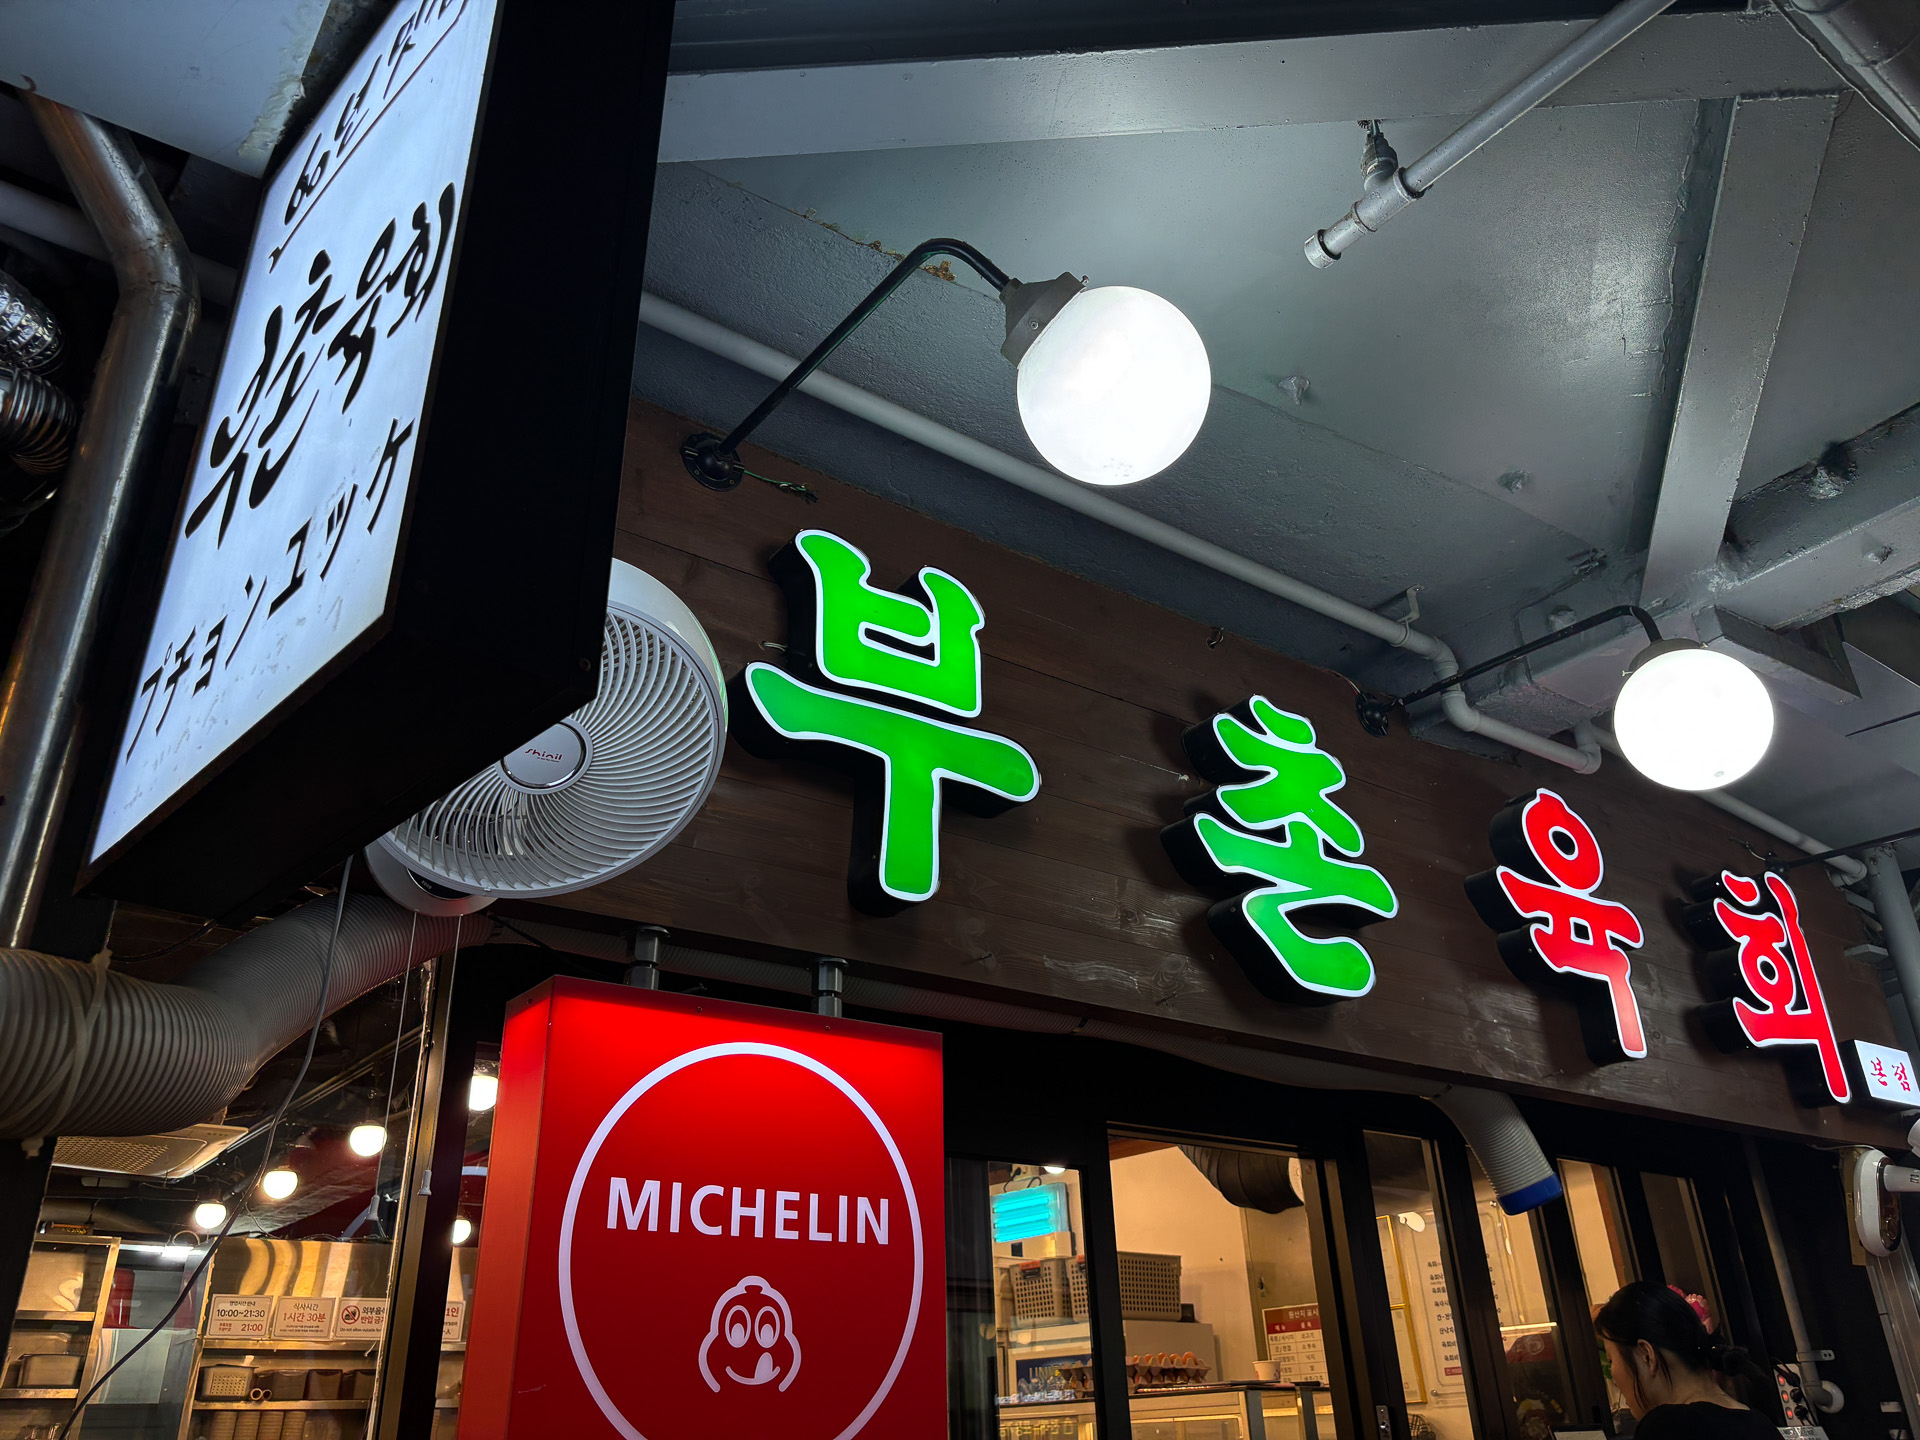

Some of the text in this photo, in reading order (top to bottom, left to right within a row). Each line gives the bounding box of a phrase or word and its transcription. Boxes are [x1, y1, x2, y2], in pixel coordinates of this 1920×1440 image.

[186, 182, 456, 548] 부촌육회
[1870, 1056, 1911, 1092] 본점
[606, 1176, 889, 1245] MICHELIN
[216, 1308, 266, 1318] 10:00~21:30
[293, 1303, 319, 1312] 식사시간
[283, 1312, 326, 1323] 1시간 30분
[240, 1323, 263, 1332] 21:00
